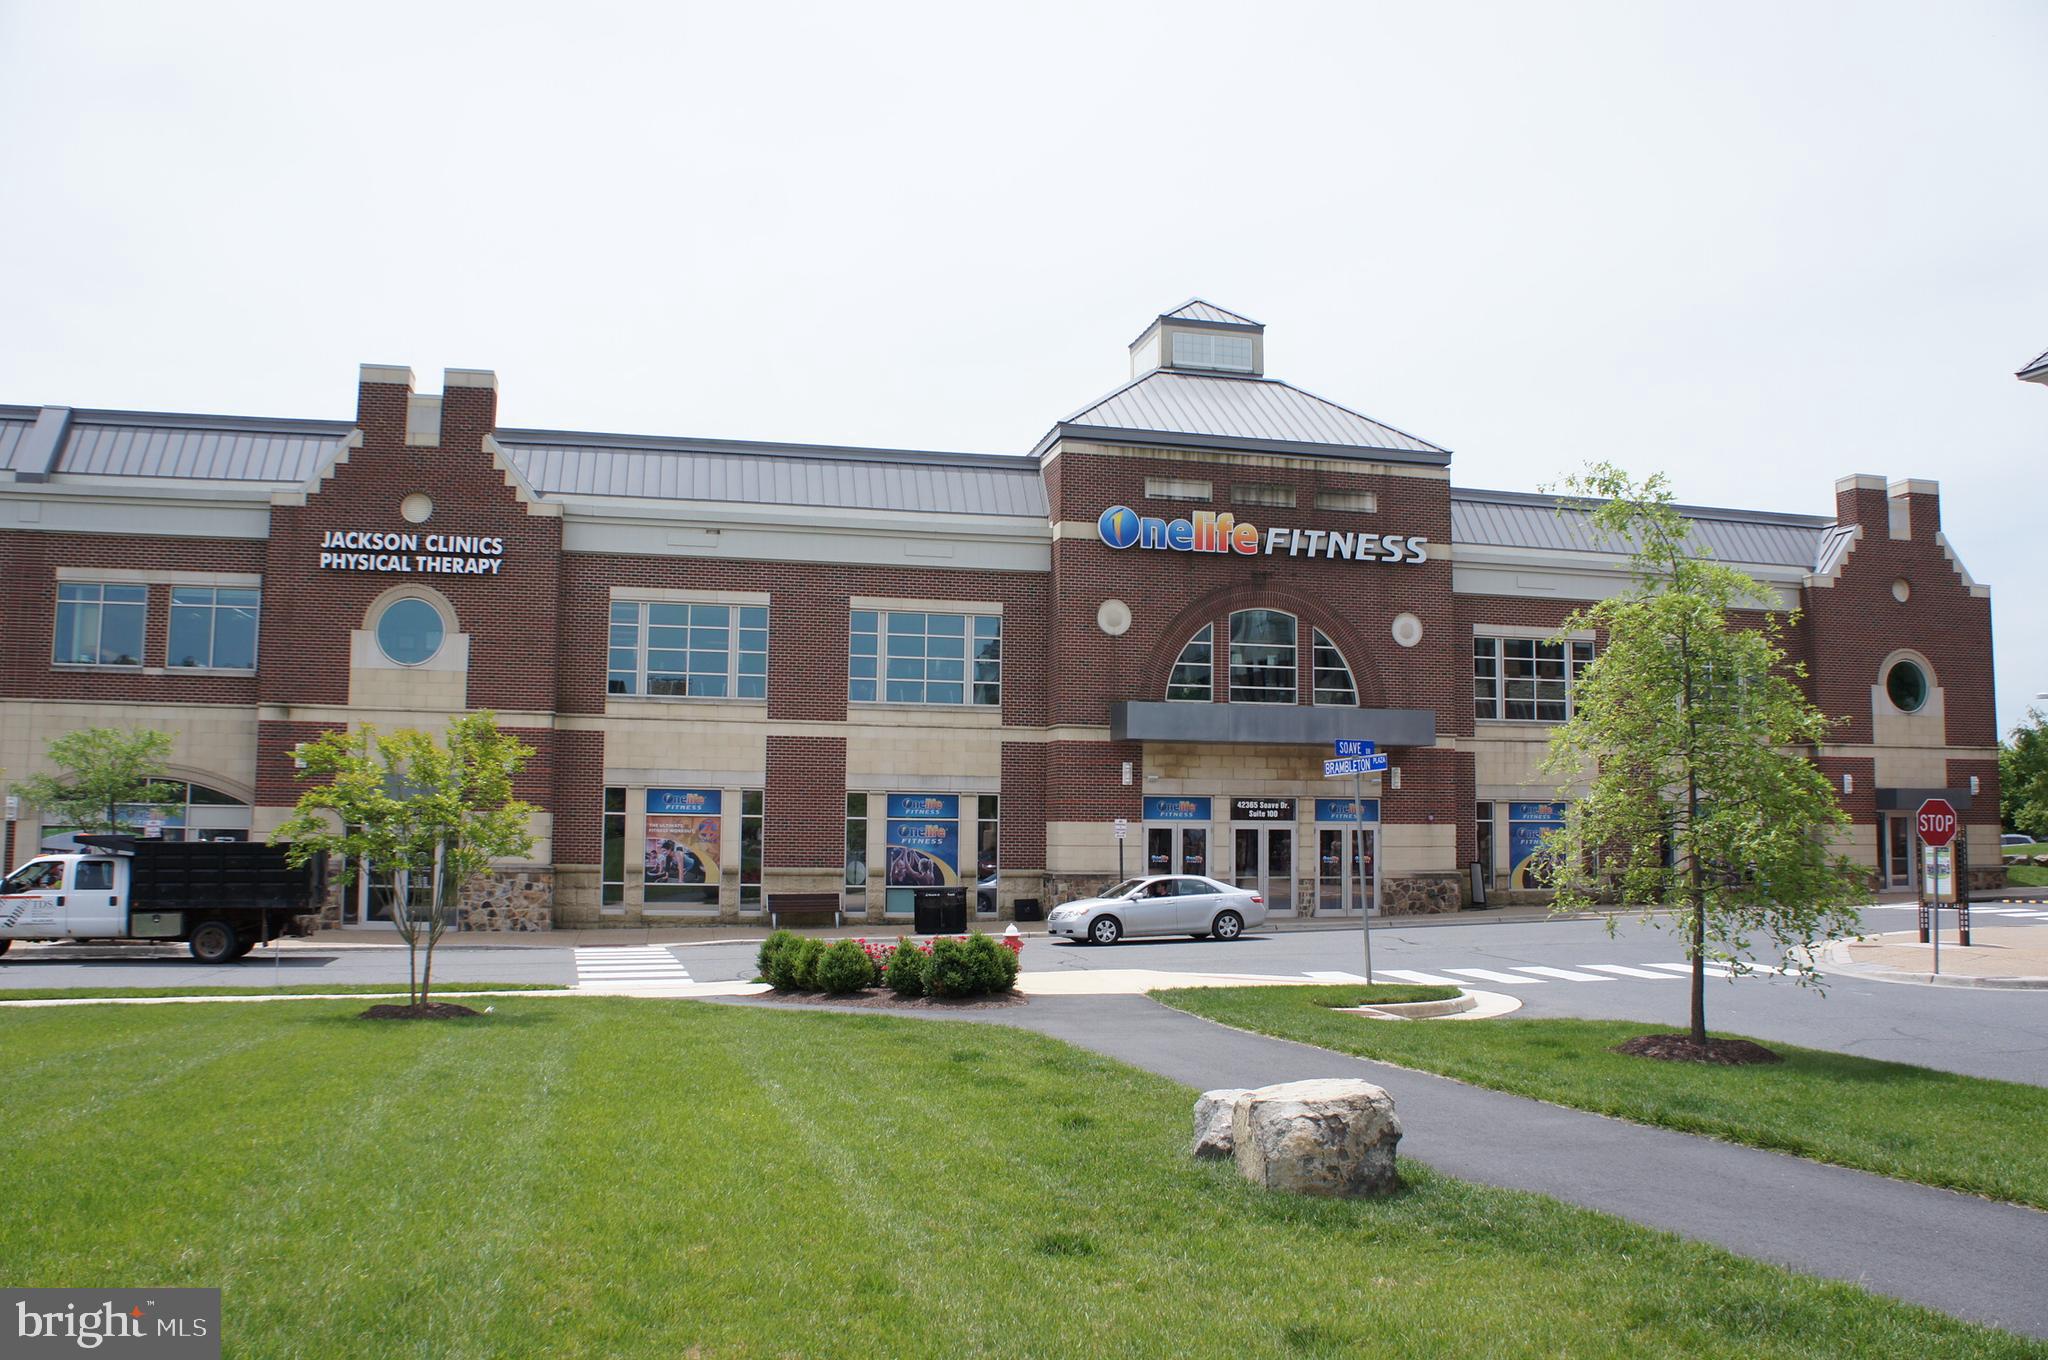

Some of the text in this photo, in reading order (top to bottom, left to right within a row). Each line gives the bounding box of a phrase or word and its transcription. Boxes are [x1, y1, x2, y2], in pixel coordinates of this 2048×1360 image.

[320, 531, 503, 555] JACKSON CLINICS
[1097, 505, 1428, 564] Onelife FITNESS
[320, 552, 502, 575] PHYSICAL THERAPY
[1339, 741, 1362, 755] SOAVE
[1325, 756, 1386, 775] BRAMBLETON PLAZA
[1237, 801, 1290, 809] 42365 Soave Dr.
[1248, 810, 1279, 818] Suite 100
[897, 824, 946, 838] Onelife
[1919, 814, 1954, 832] STOP
